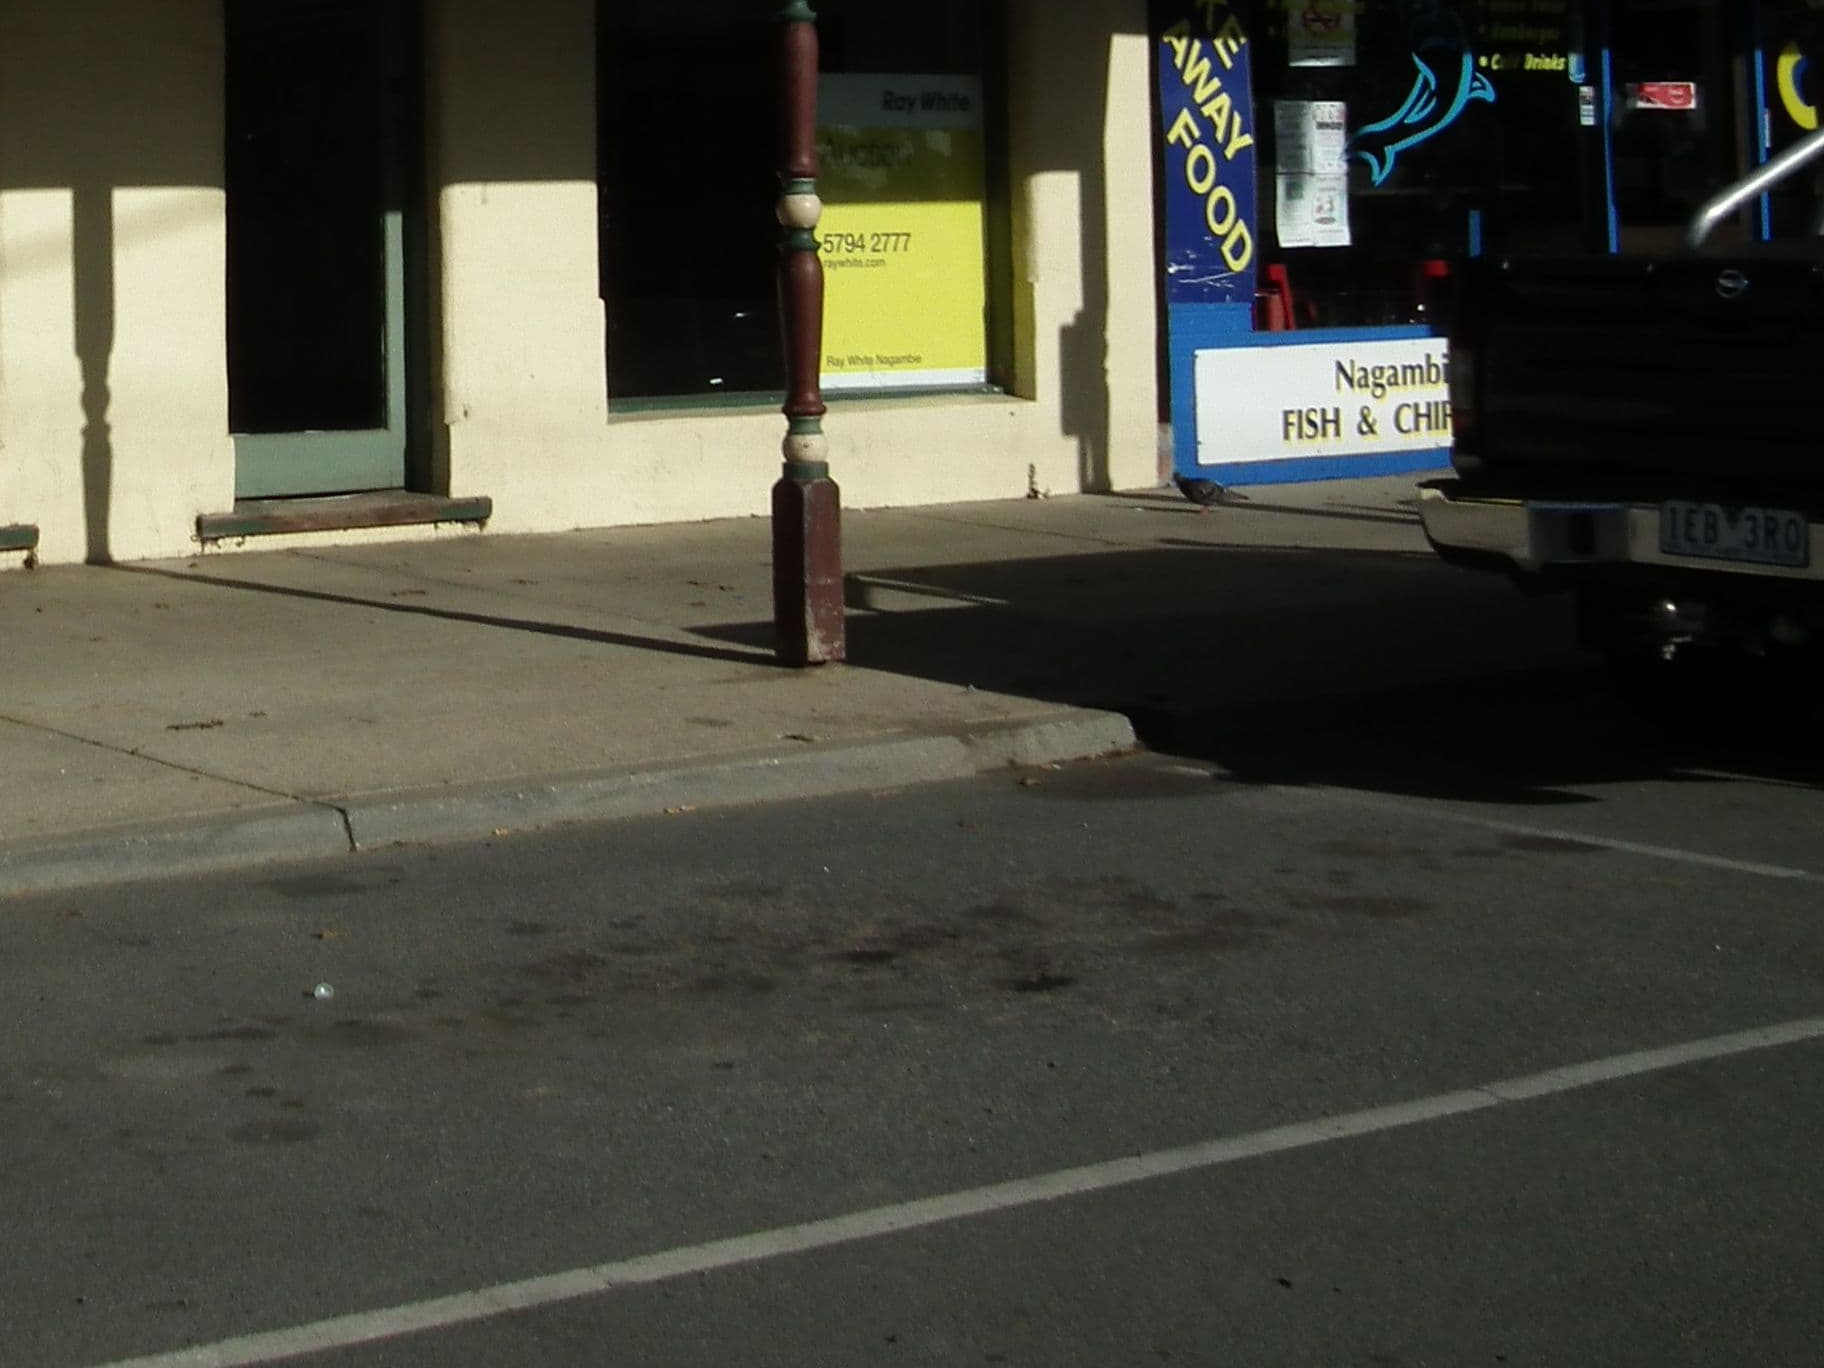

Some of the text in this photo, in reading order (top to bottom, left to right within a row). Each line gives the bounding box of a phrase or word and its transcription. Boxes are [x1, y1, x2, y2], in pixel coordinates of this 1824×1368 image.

[882, 90, 971, 114] Ray White
[1162, 18, 1255, 161] AWAY
[1165, 106, 1254, 273] FOOD
[823, 232, 911, 253] 5794 2777
[1334, 352, 1451, 400] Nagambi
[1282, 406, 1342, 441] FISH
[1355, 405, 1379, 437] &
